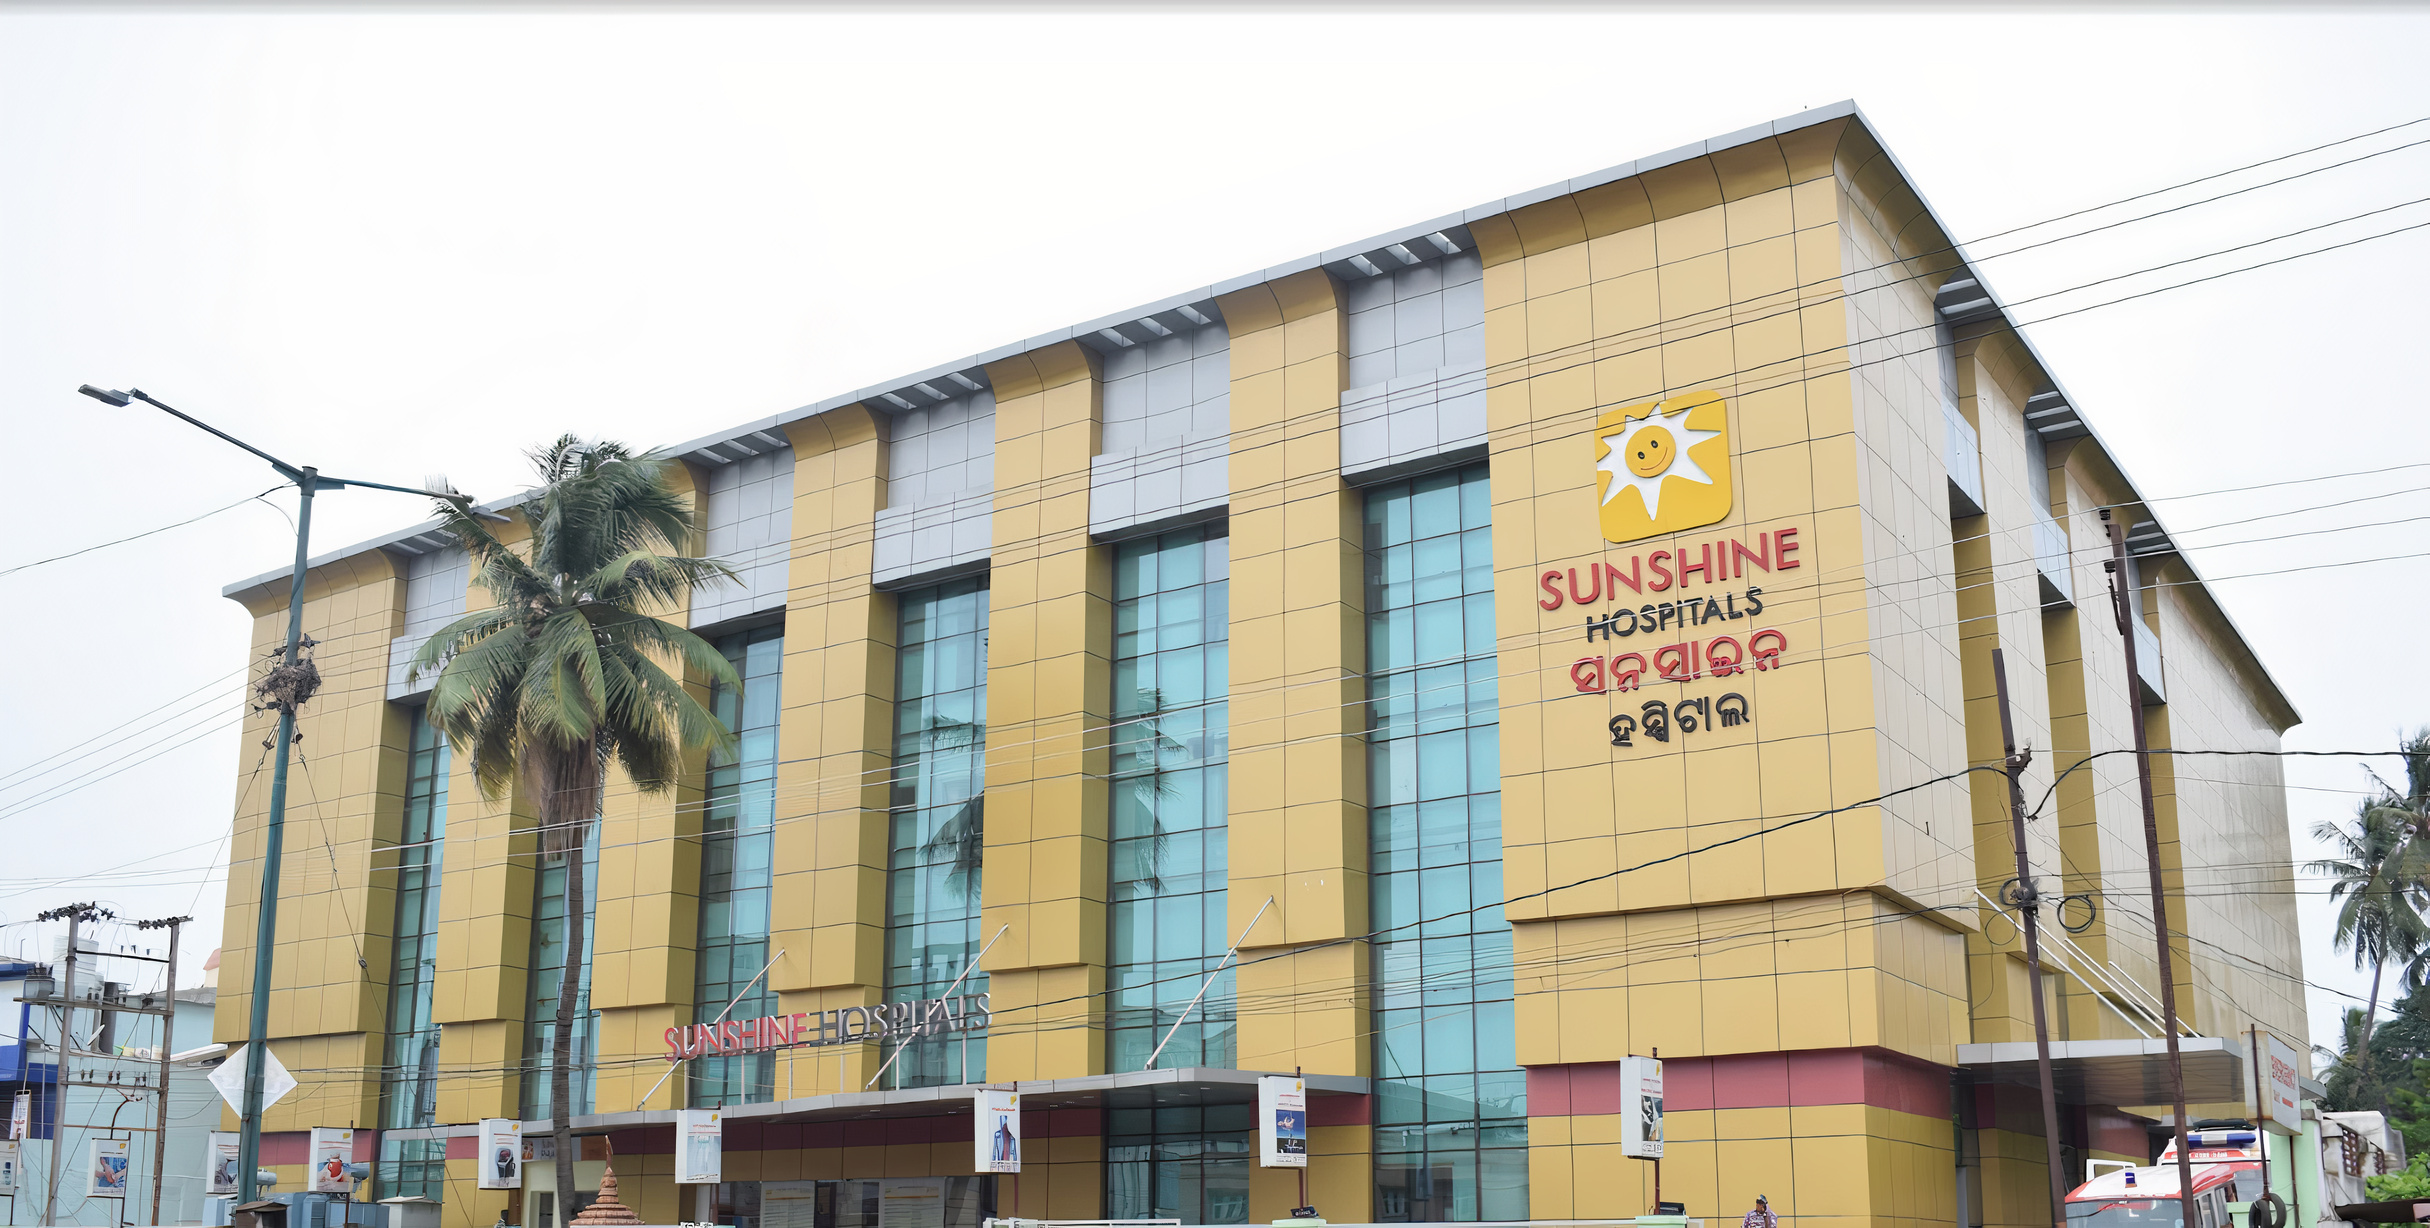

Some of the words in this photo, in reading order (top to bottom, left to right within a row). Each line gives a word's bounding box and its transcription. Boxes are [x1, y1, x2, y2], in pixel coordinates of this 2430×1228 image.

[1540, 528, 1800, 611] SUNSHINE
[1586, 586, 1763, 643] HOSPITALS
[664, 1012, 811, 1063] SUNSHINE
[818, 993, 993, 1045] HOSPITALS
